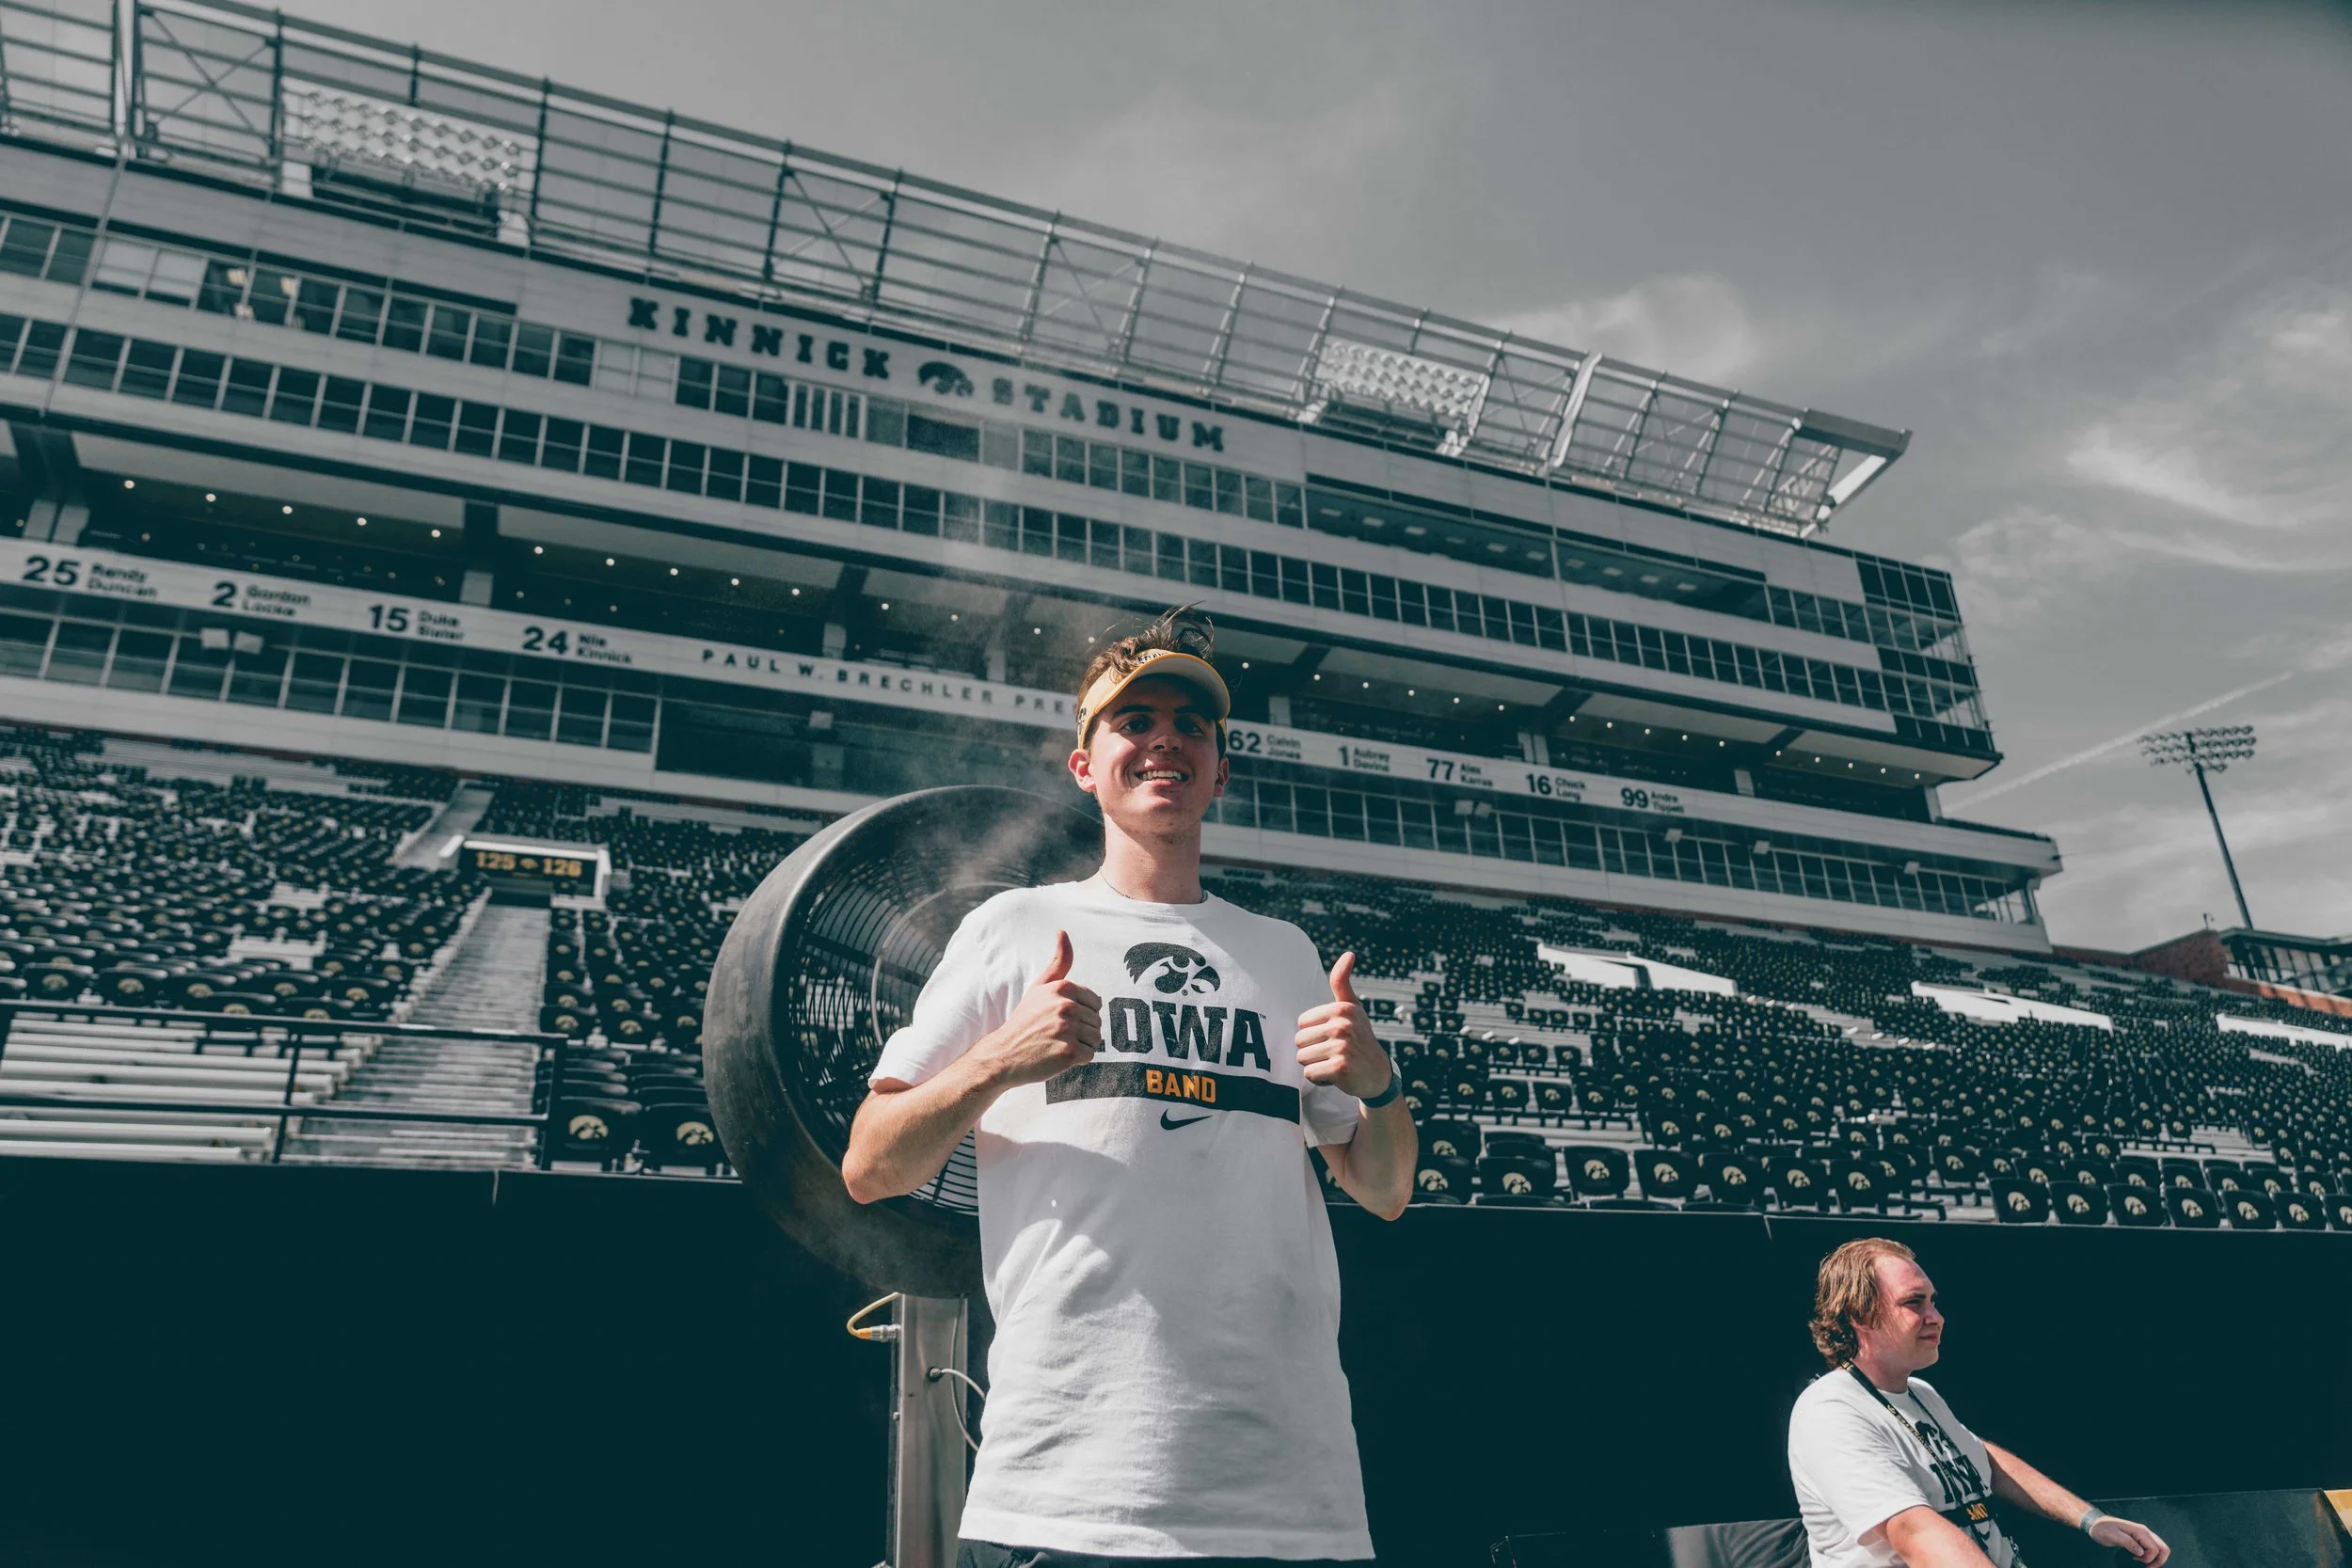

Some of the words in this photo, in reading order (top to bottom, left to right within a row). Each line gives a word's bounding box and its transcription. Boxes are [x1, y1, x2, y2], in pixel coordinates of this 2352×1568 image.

[628, 297, 890, 380] KINNICK
[992, 377, 1224, 452] STADIUM
[23, 555, 81, 586] 25
[212, 580, 238, 608] 2
[370, 605, 409, 632] 15
[522, 626, 568, 656] 24
[702, 649, 781, 673] PAUL
[837, 669, 993, 705] BRECHLER
[1229, 729, 1262, 753] 62
[1338, 745, 1348, 767] 1
[1425, 757, 1454, 781] 77
[1525, 772, 1552, 796] 16
[1620, 786, 1649, 809] 99
[476, 851, 516, 871] 125
[1092, 997, 1271, 1073] OWA
[1146, 1069, 1216, 1104] BAND
